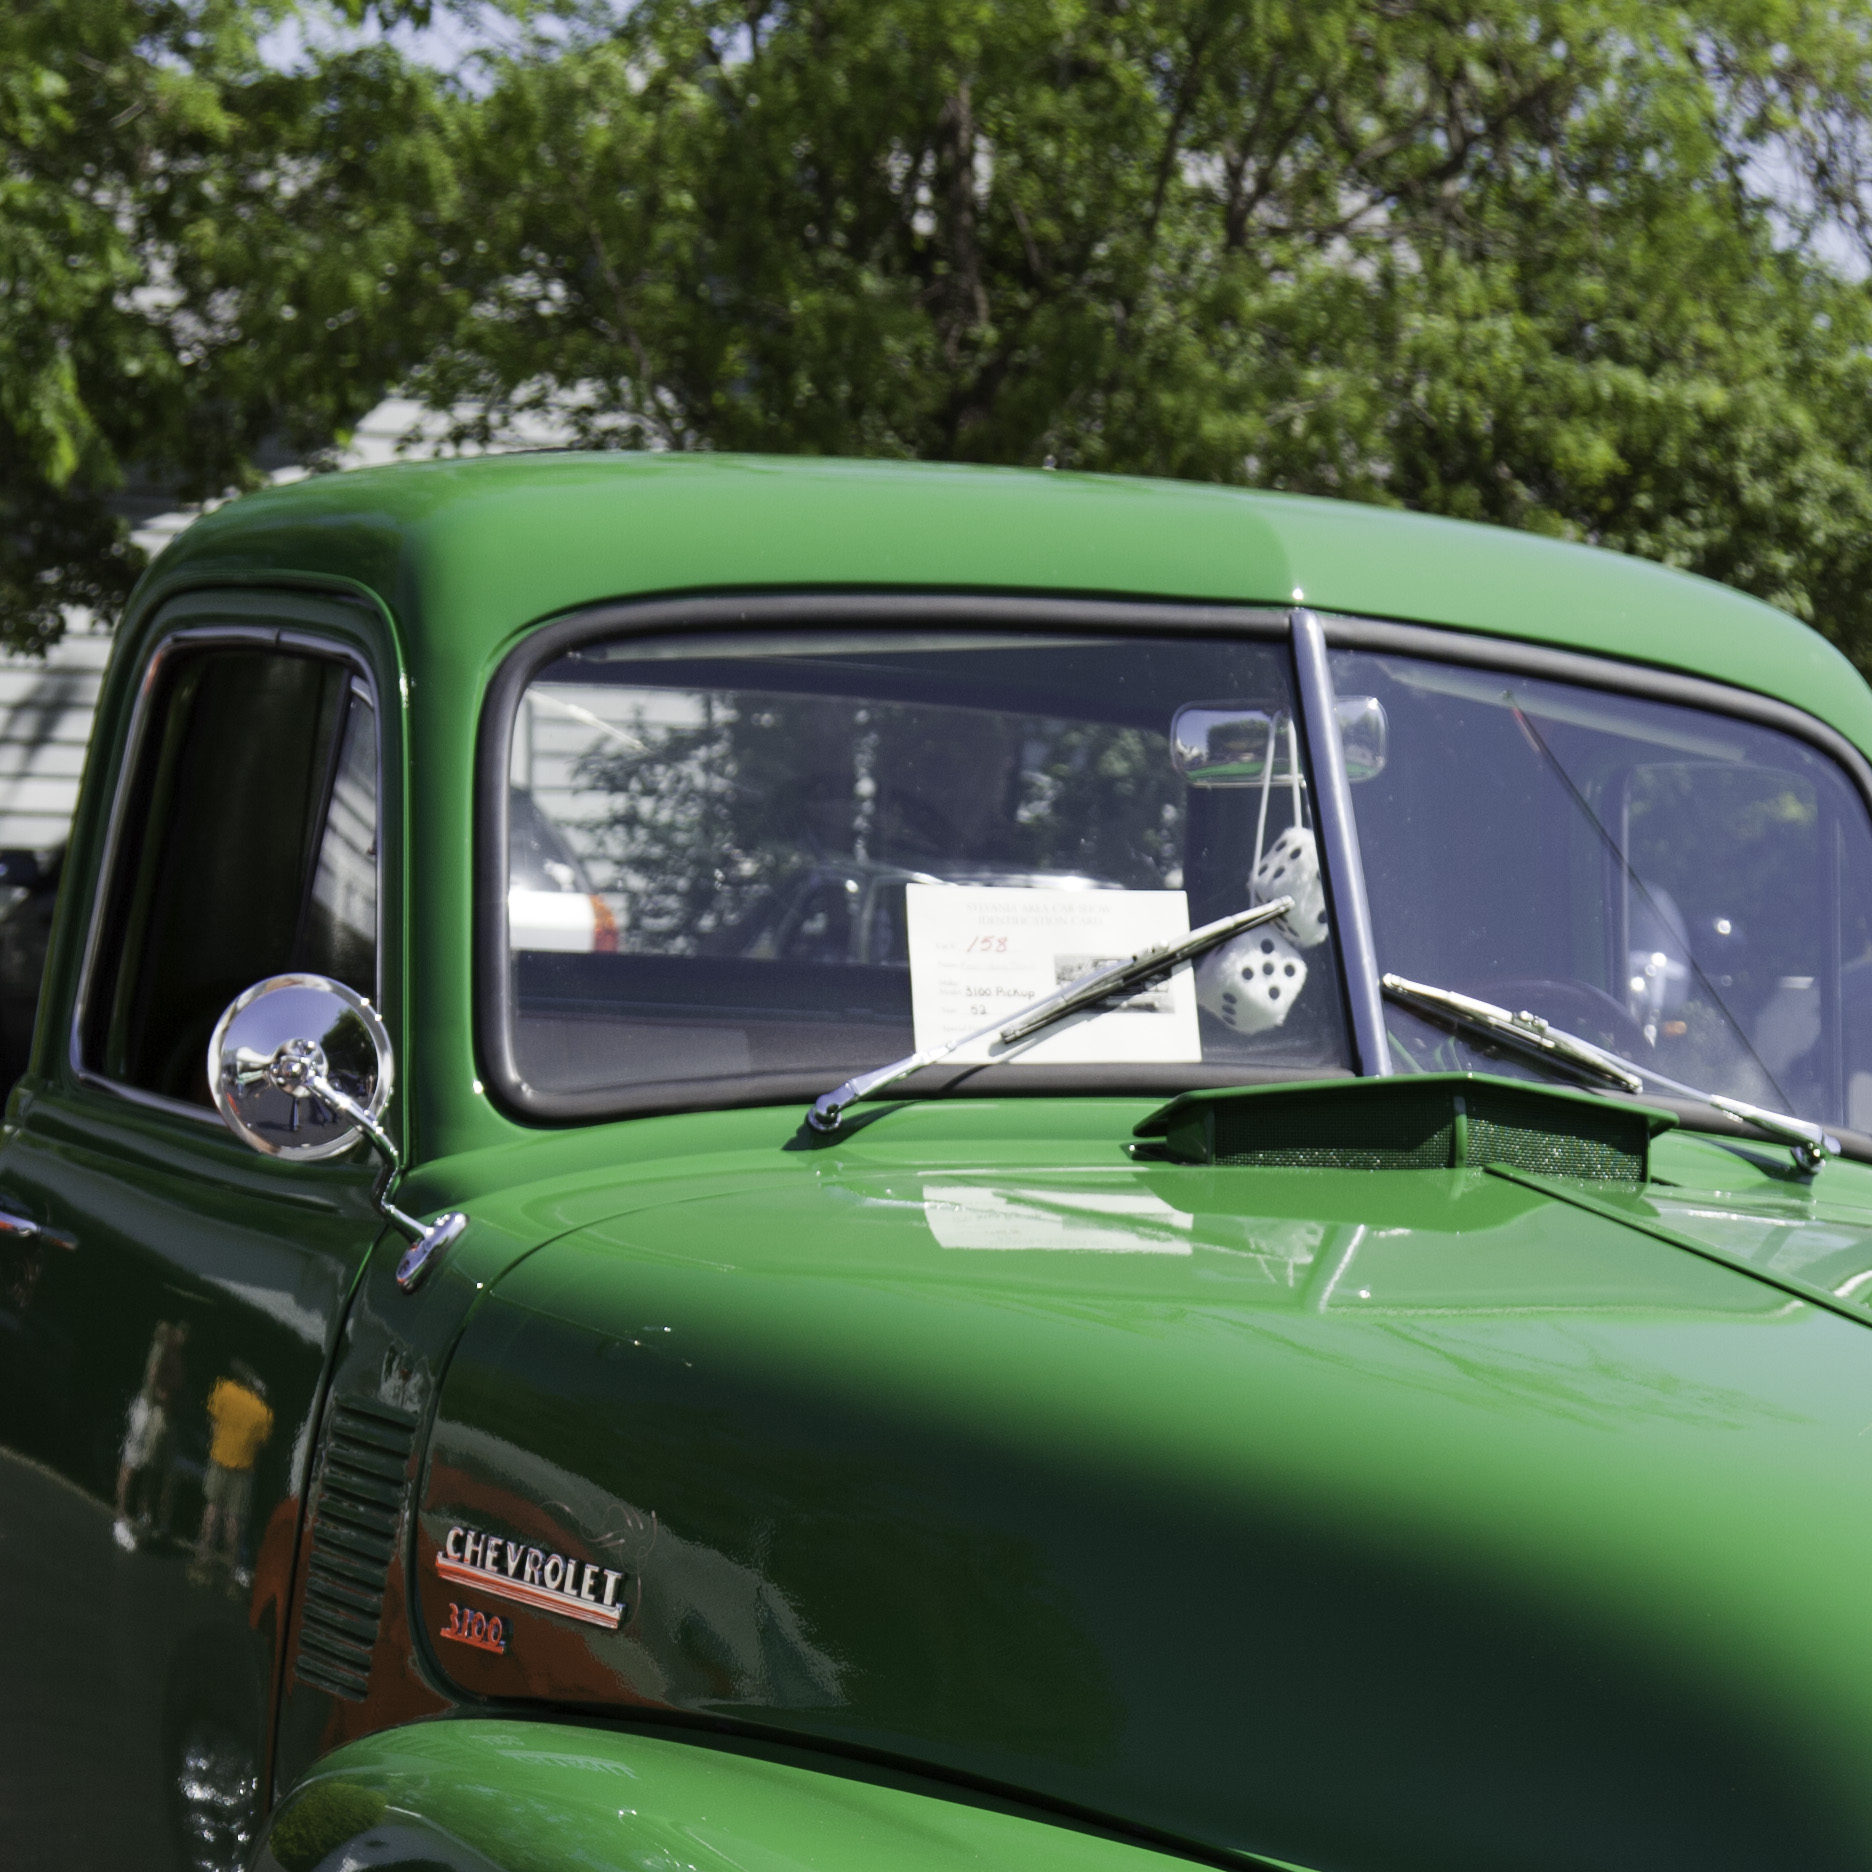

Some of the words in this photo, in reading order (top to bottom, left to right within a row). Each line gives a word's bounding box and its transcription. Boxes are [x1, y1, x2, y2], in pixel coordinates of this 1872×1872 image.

[1052, 903, 1074, 914] CAR
[966, 935, 1008, 952] 158
[965, 985, 992, 997] 3100
[446, 1526, 625, 1606] CHEVROLET
[448, 1602, 503, 1645] 3100
